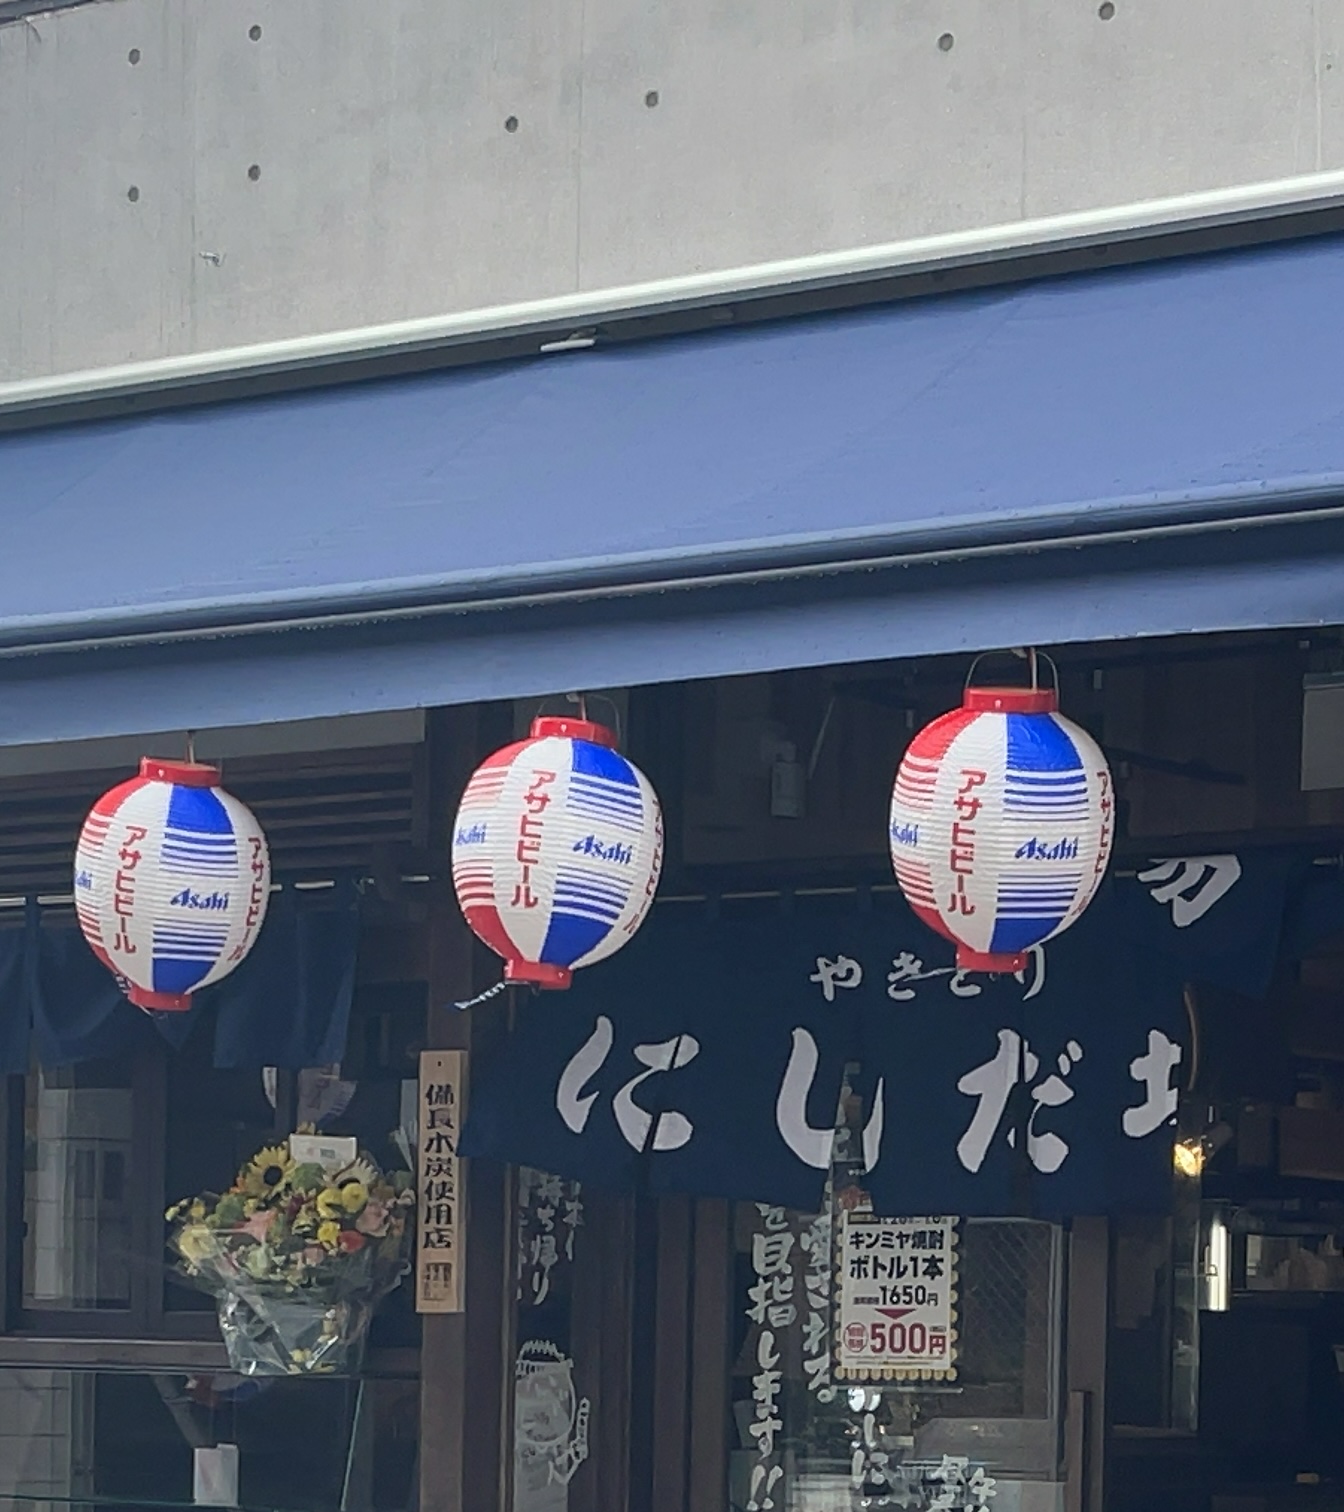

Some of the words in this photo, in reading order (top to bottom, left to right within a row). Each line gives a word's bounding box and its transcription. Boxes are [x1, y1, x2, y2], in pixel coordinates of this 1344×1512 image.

[511, 769, 556, 909] アサヒビール
[572, 835, 633, 865] Asahi
[948, 770, 987, 916] アサヒビール
[1015, 837, 1079, 859] Asahi
[114, 826, 148, 953] アサヒビール
[170, 888, 230, 911] Asahi
[849, 1230, 944, 1251] キンミヤ焼酎
[850, 1254, 944, 1281] ボトル1本
[879, 1285, 938, 1306] 1650円
[870, 1323, 946, 1355] 500円
